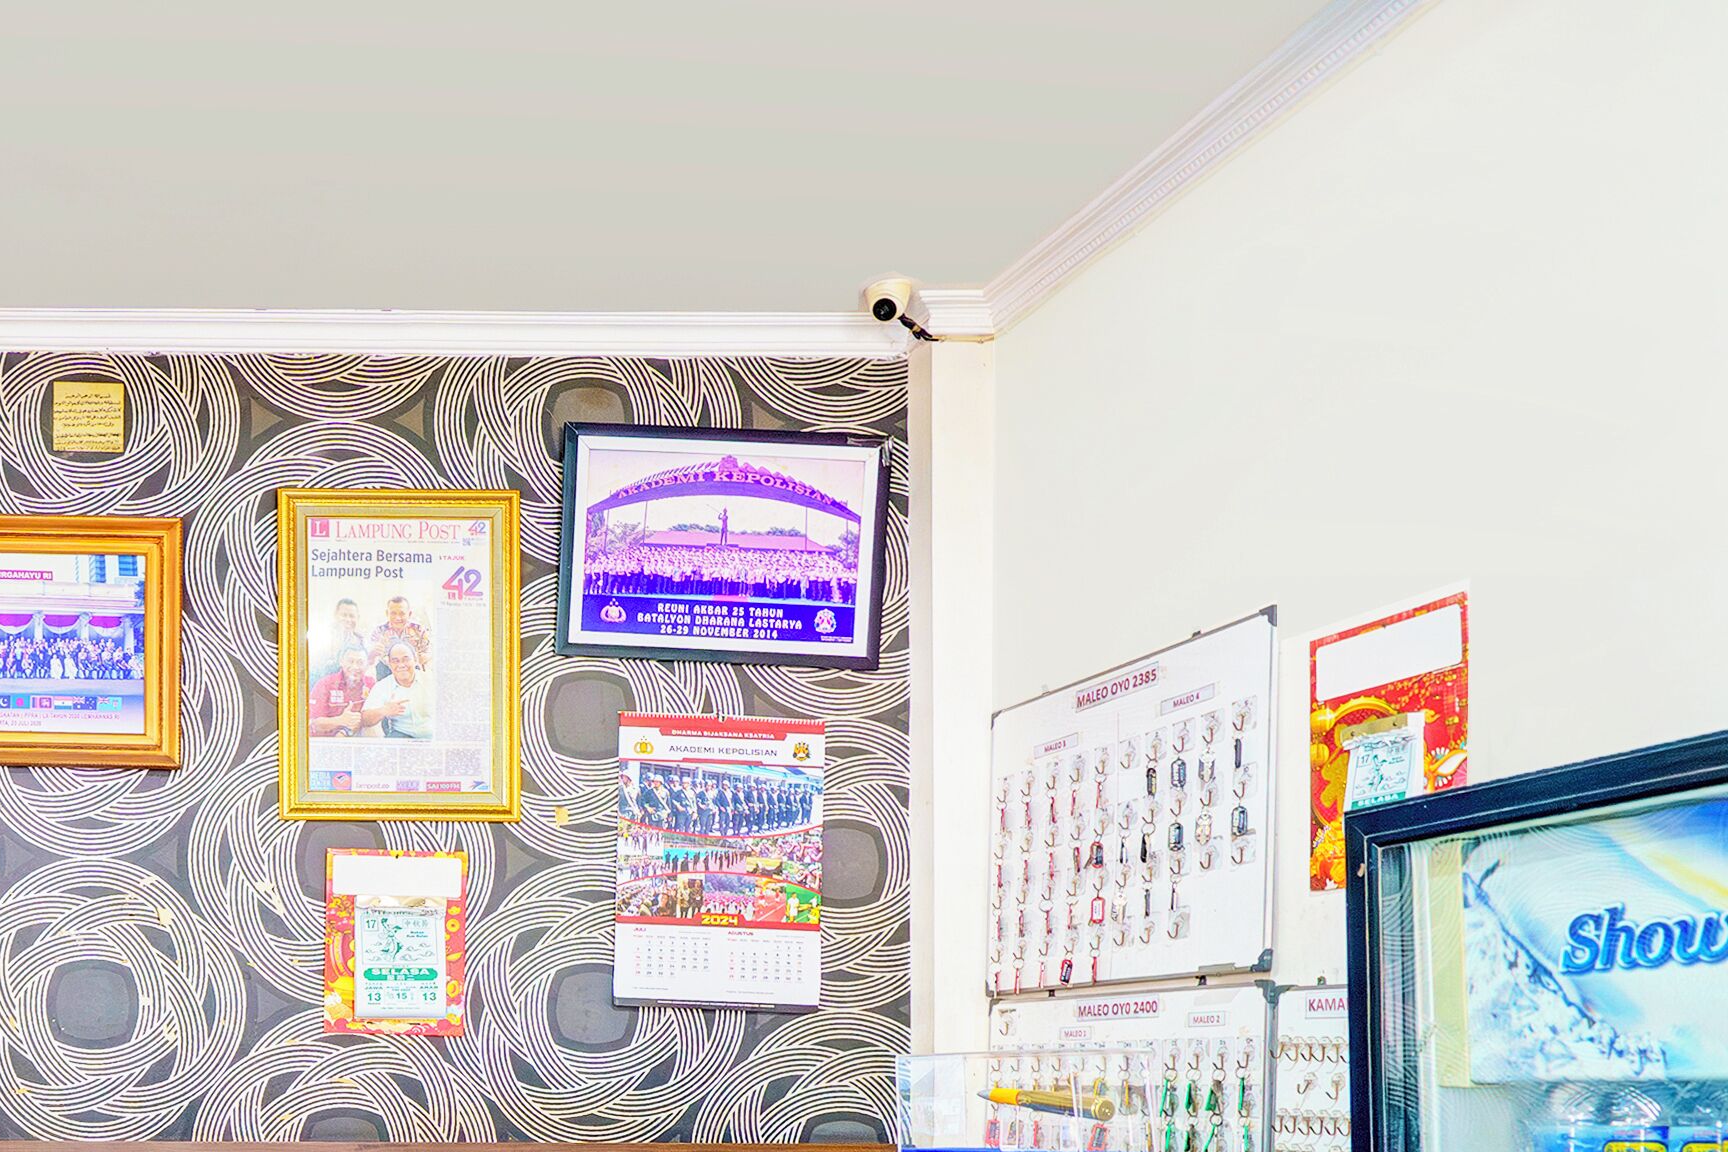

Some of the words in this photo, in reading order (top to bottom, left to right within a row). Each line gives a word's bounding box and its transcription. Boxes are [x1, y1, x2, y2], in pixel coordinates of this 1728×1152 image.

[617, 472, 705, 499] AKADEMI
[714, 471, 834, 505] KEPOLISIAN
[336, 521, 412, 540] LAMPUNG
[419, 521, 462, 540] POST
[311, 549, 373, 563] Sejahtera
[376, 550, 433, 564] Bersama
[42, 572, 52, 580] RI
[311, 565, 372, 579] Lampung
[375, 566, 404, 579] Post
[441, 565, 483, 600] 42
[657, 603, 690, 614] REUNI
[693, 604, 729, 616] AKBAR
[732, 606, 746, 616] 25
[749, 607, 784, 618] TAHUN
[637, 613, 691, 625] BATALYON
[695, 615, 745, 627] DHARANA
[749, 618, 803, 630] LASTARYA
[660, 624, 689, 635] 26-29
[692, 626, 749, 638] NOVEMBER
[753, 628, 778, 639] 2014
[1076, 686, 1109, 708] MALEO
[1132, 668, 1157, 688] 2385
[1173, 694, 1195, 707] MALEO
[669, 745, 715, 754] AKADEMI
[718, 748, 778, 756] KEPOLISIAN
[366, 919, 377, 929] 17
[701, 914, 738, 925] 2024
[367, 992, 382, 1001] 13
[422, 992, 437, 1001] 13
[1078, 1003, 1109, 1017] MALEO
[1133, 1000, 1158, 1014] 2400
[1308, 997, 1349, 1012] KAMA
[1192, 1016, 1214, 1024] MALEO
